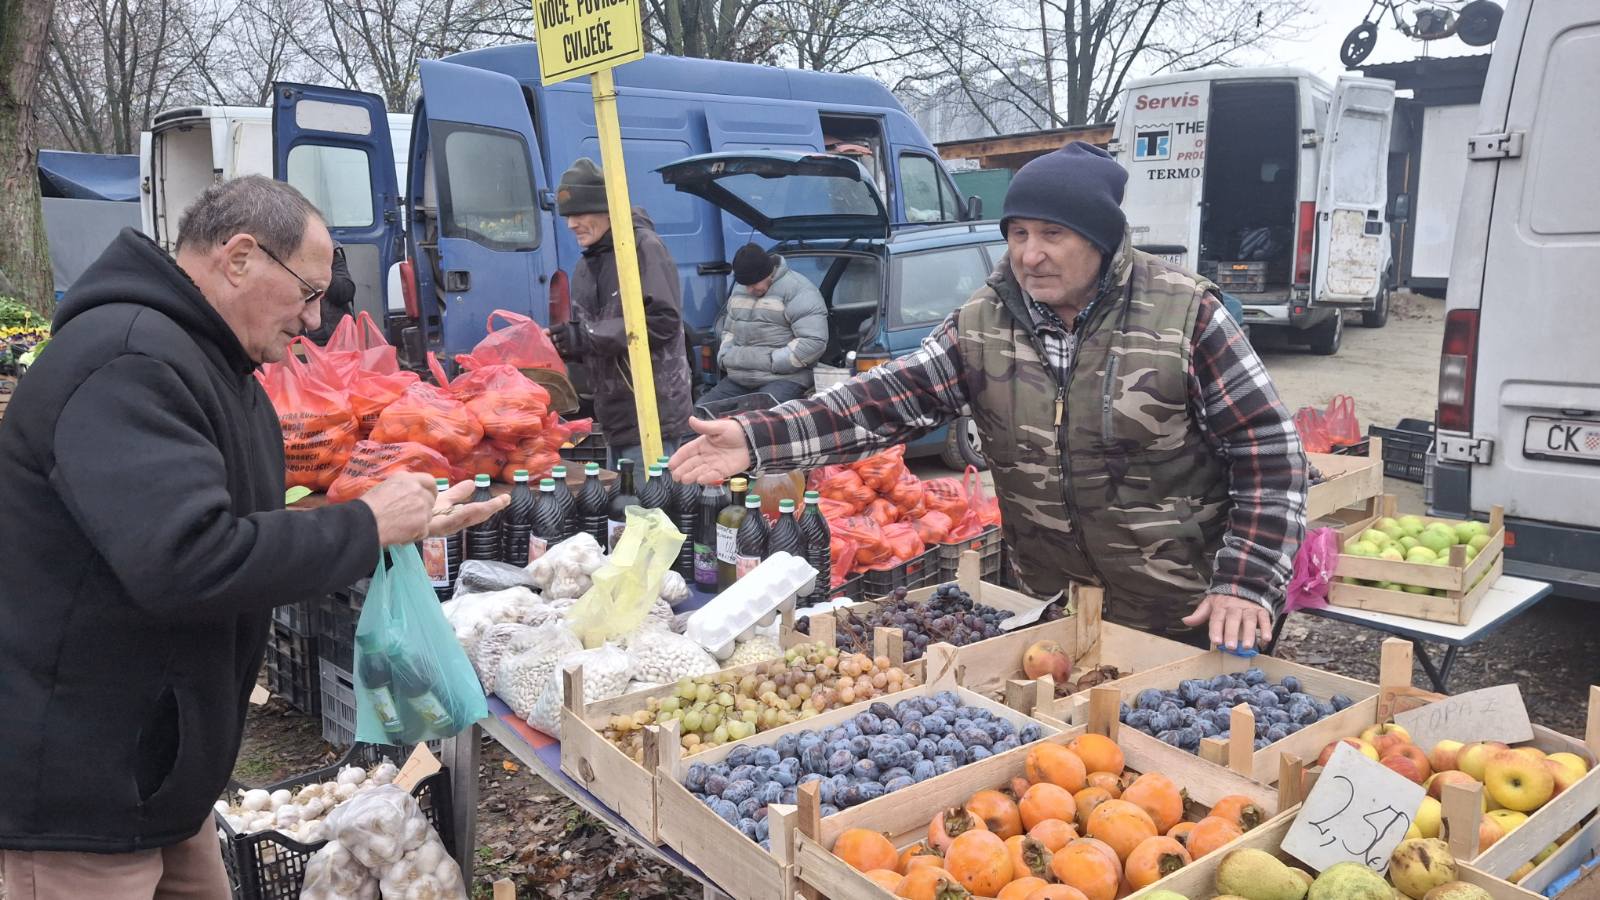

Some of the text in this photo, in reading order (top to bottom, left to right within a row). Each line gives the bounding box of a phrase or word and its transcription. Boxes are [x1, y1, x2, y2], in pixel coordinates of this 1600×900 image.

[563, 17, 613, 64] CVIJEĆE
[1135, 92, 1200, 111] Servis
[1175, 120, 1205, 134] THE
[1147, 168, 1204, 181] TERMO
[1547, 424, 1582, 452] ČK
